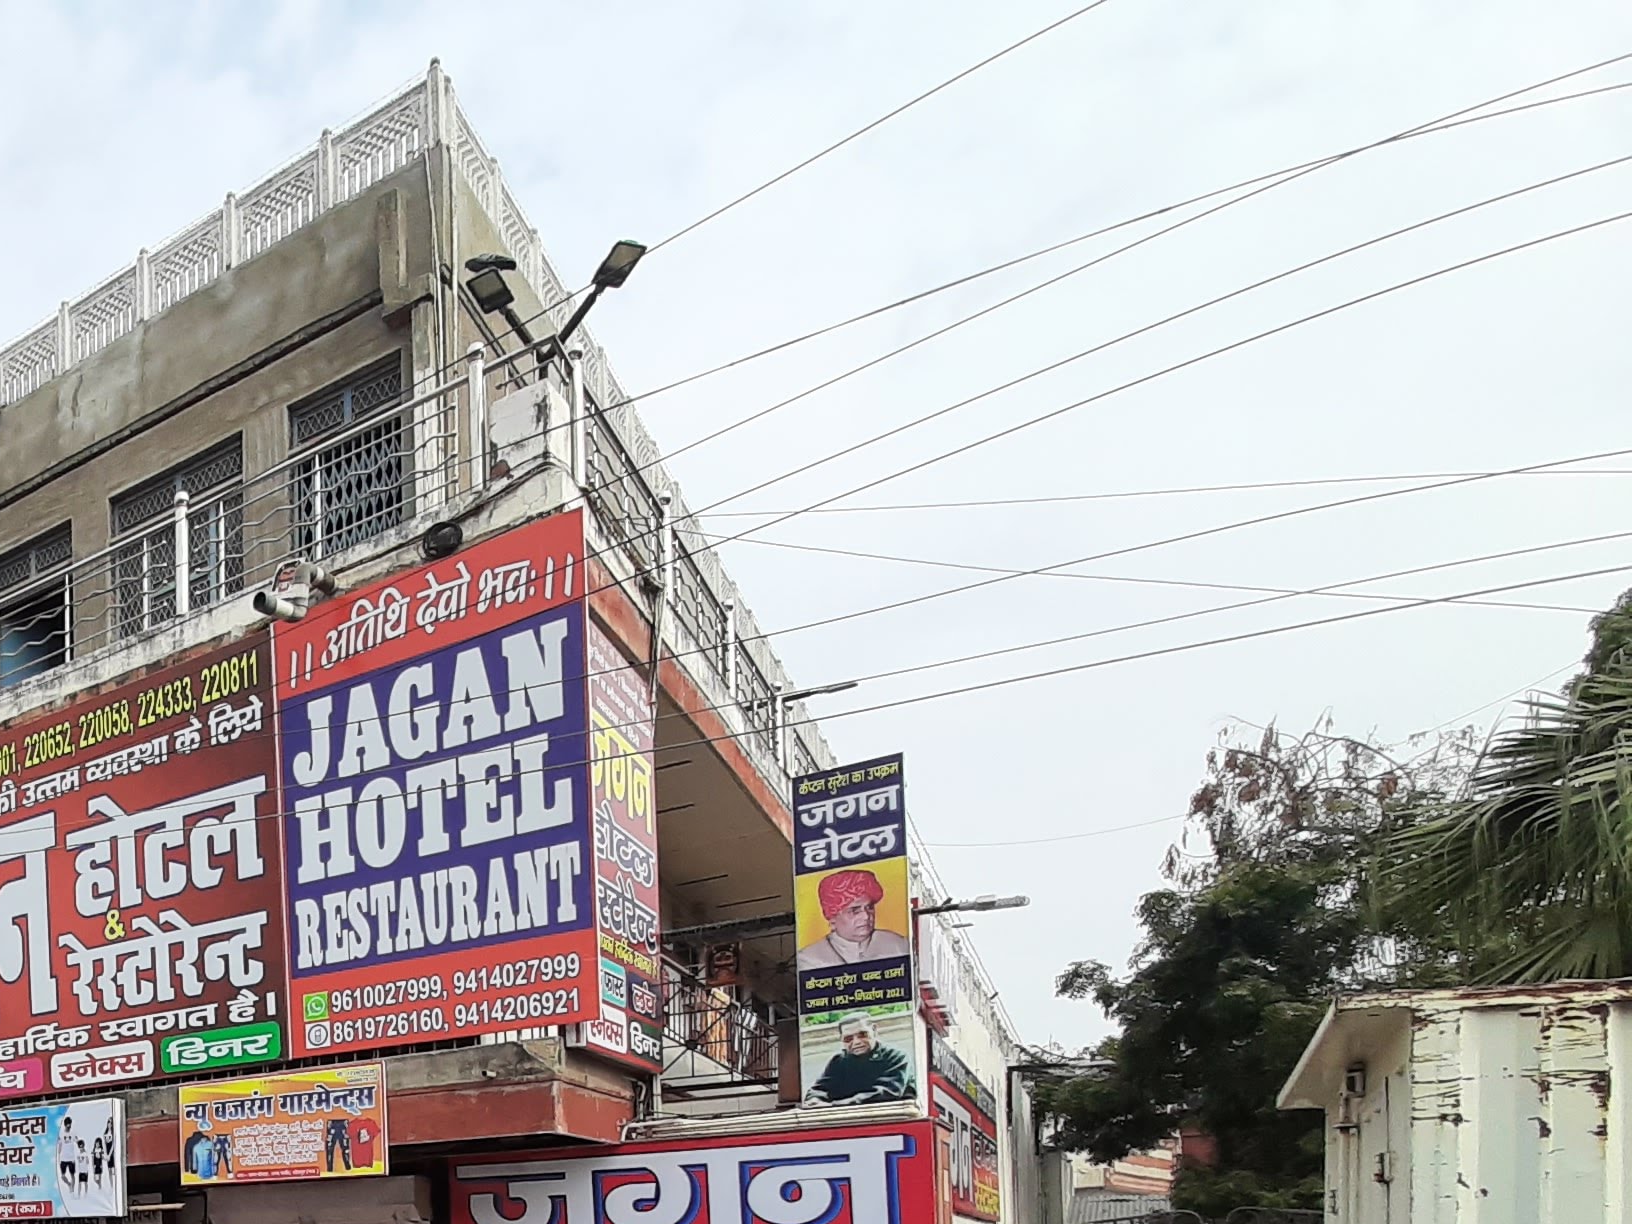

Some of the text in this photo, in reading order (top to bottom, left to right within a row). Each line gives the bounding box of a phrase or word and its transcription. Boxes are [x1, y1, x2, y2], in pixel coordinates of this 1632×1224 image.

[321, 595, 408, 670] अतिथि
[200, 649, 260, 708] 220811
[291, 616, 573, 788] JAGAN
[173, 716, 202, 754] के
[207, 694, 265, 742] लिये
[294, 732, 574, 885] HOTEL
[798, 784, 901, 827] जगन
[65, 773, 268, 919] होटल
[800, 823, 900, 869] होटल
[103, 908, 127, 942] &
[294, 840, 582, 970] RESTAURANT
[453, 951, 581, 994] 9414027999
[98, 1000, 220, 1042] स्वागत
[453, 988, 581, 1028] 9414206921
[165, 1033, 273, 1067] डिनर
